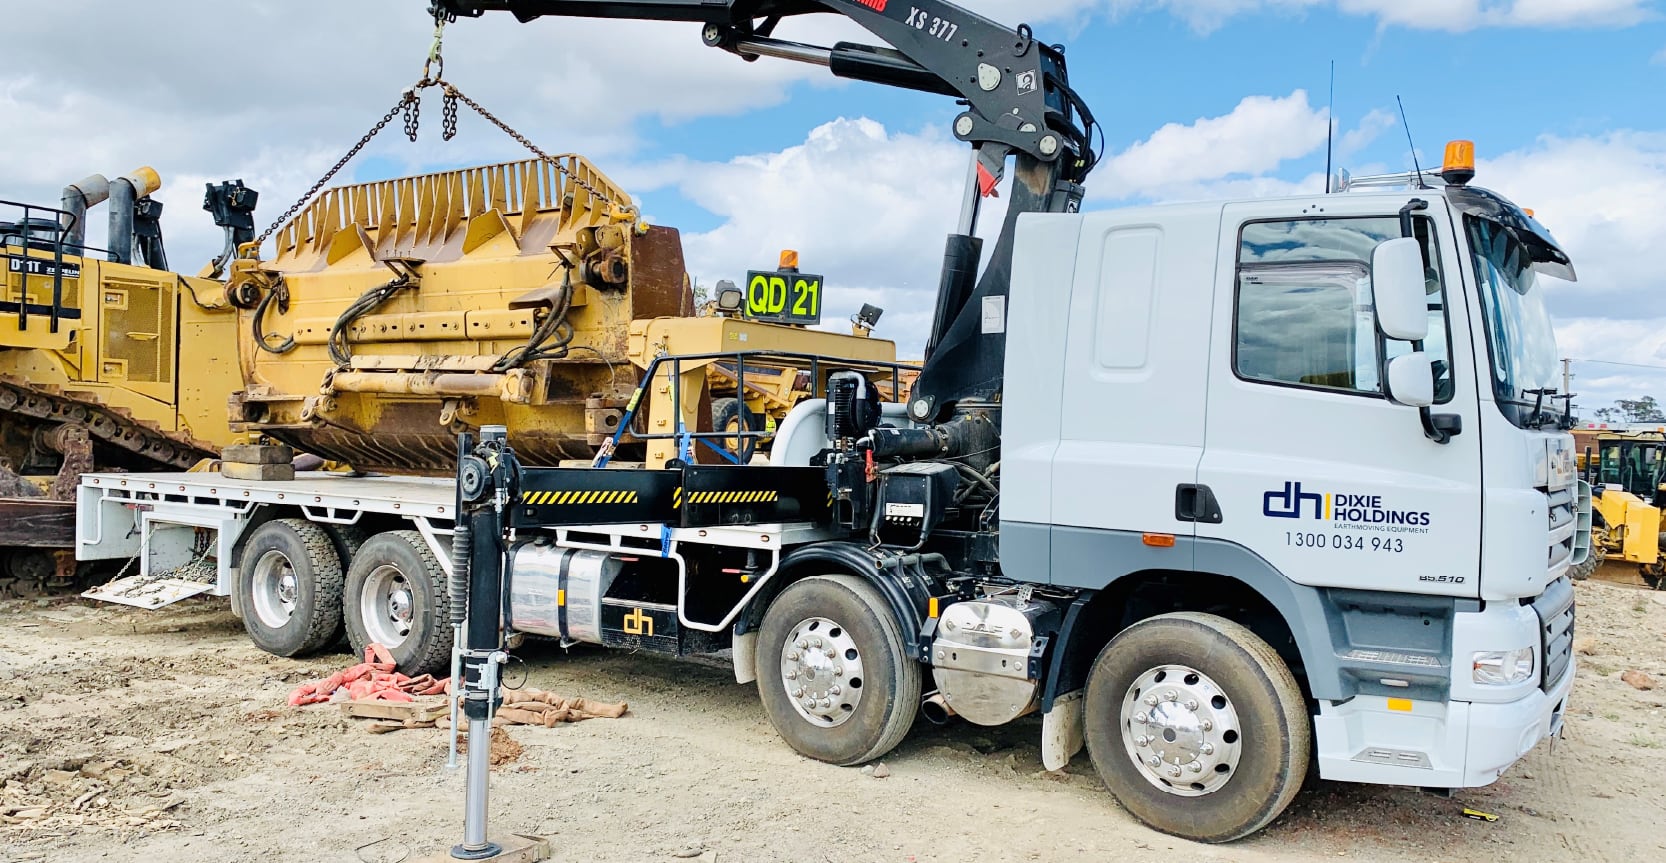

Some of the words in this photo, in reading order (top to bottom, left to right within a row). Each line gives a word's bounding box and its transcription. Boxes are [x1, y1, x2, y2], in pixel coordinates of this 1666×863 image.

[905, 6, 928, 30] XS
[929, 17, 958, 42] 377
[10, 258, 41, 272] D1T
[748, 275, 787, 314] QD
[792, 279, 819, 316] 21
[1335, 494, 1382, 508] DIXIE
[1334, 508, 1430, 525] HOLDINGS
[1334, 522, 1385, 532] EARTHMOVING
[1386, 526, 1429, 534] EQUIPMENT
[1286, 531, 1326, 548] 1300
[1332, 534, 1364, 550] 034
[1371, 537, 1403, 553] 943
[624, 607, 653, 637] dh
